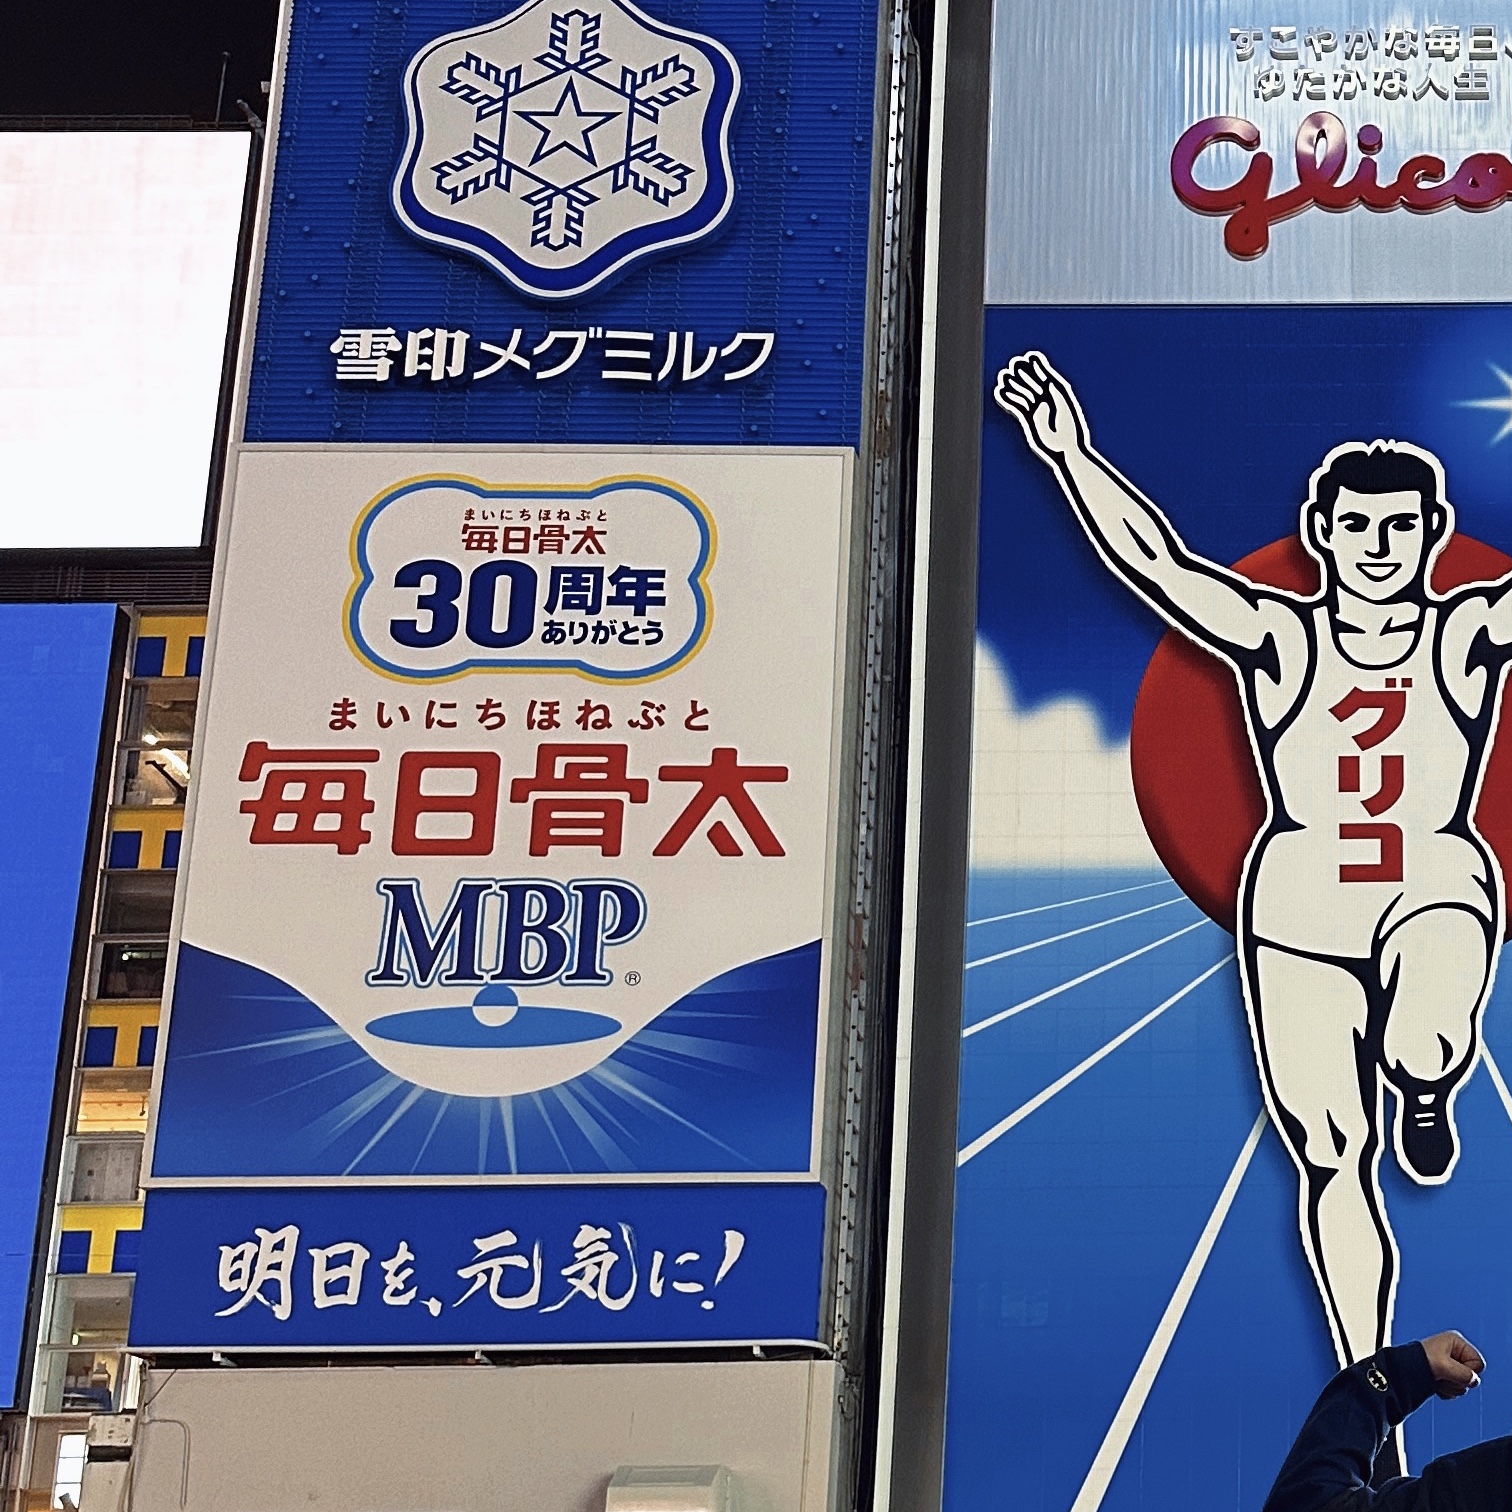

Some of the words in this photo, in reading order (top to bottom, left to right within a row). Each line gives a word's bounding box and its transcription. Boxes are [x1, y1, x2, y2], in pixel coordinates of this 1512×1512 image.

[1253, 63, 1490, 101] ゆたかな人生
[329, 326, 775, 384] 雪印メグミルク
[464, 508, 608, 522] まいにちほねぶと
[461, 523, 607, 555] 毎日骨太
[540, 619, 664, 646] ありがとう
[328, 697, 713, 732] まいにちほねぶと
[1328, 677, 1413, 883] グリコ
[238, 741, 789, 858] 毎日骨太
[366, 877, 646, 989] MBP
